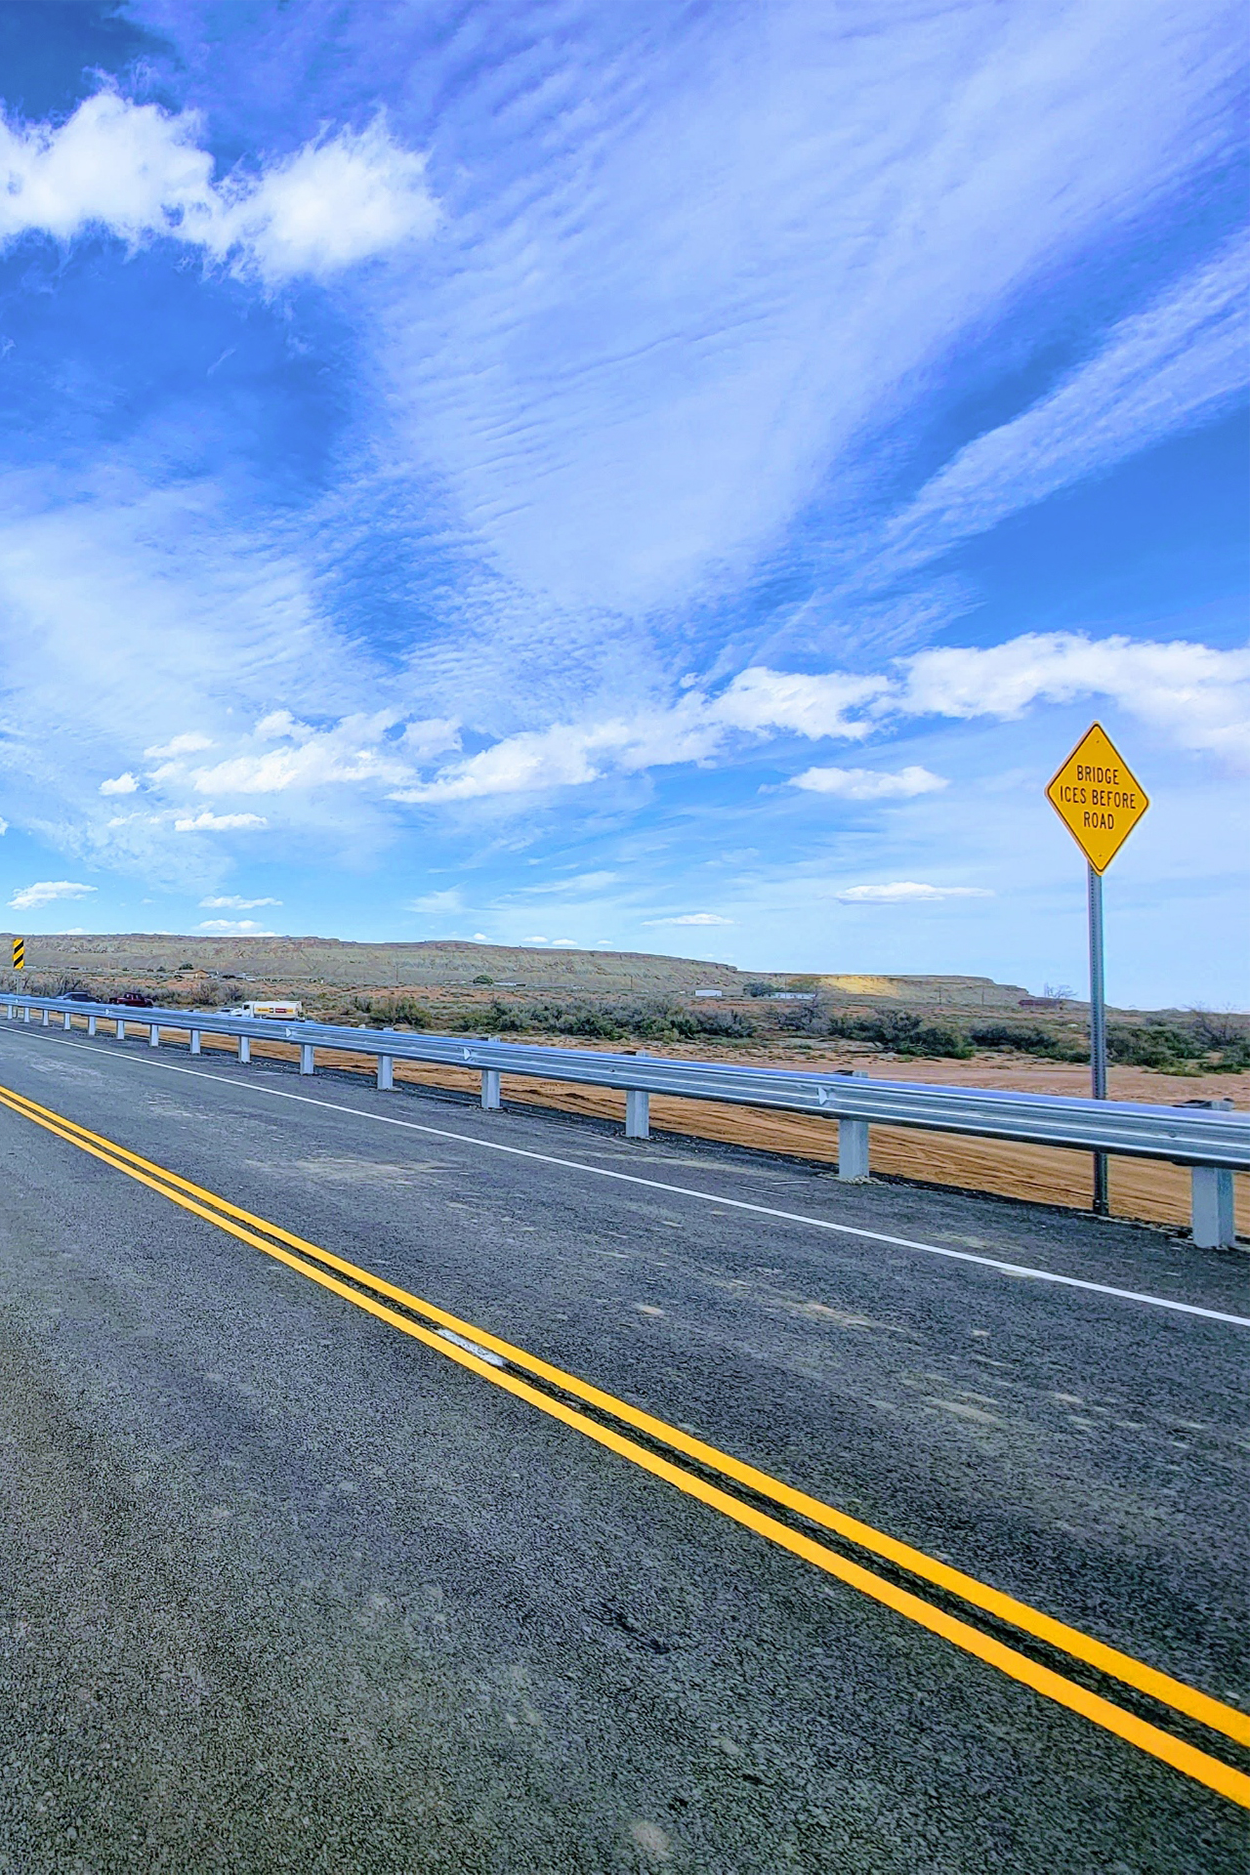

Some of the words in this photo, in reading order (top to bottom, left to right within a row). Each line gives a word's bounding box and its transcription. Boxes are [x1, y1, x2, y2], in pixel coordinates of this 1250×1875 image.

[1077, 765, 1119, 785] BRIDGE
[1060, 785, 1086, 804] ICES
[1092, 790, 1136, 809] BEFORE
[1083, 811, 1115, 830] ROAD
